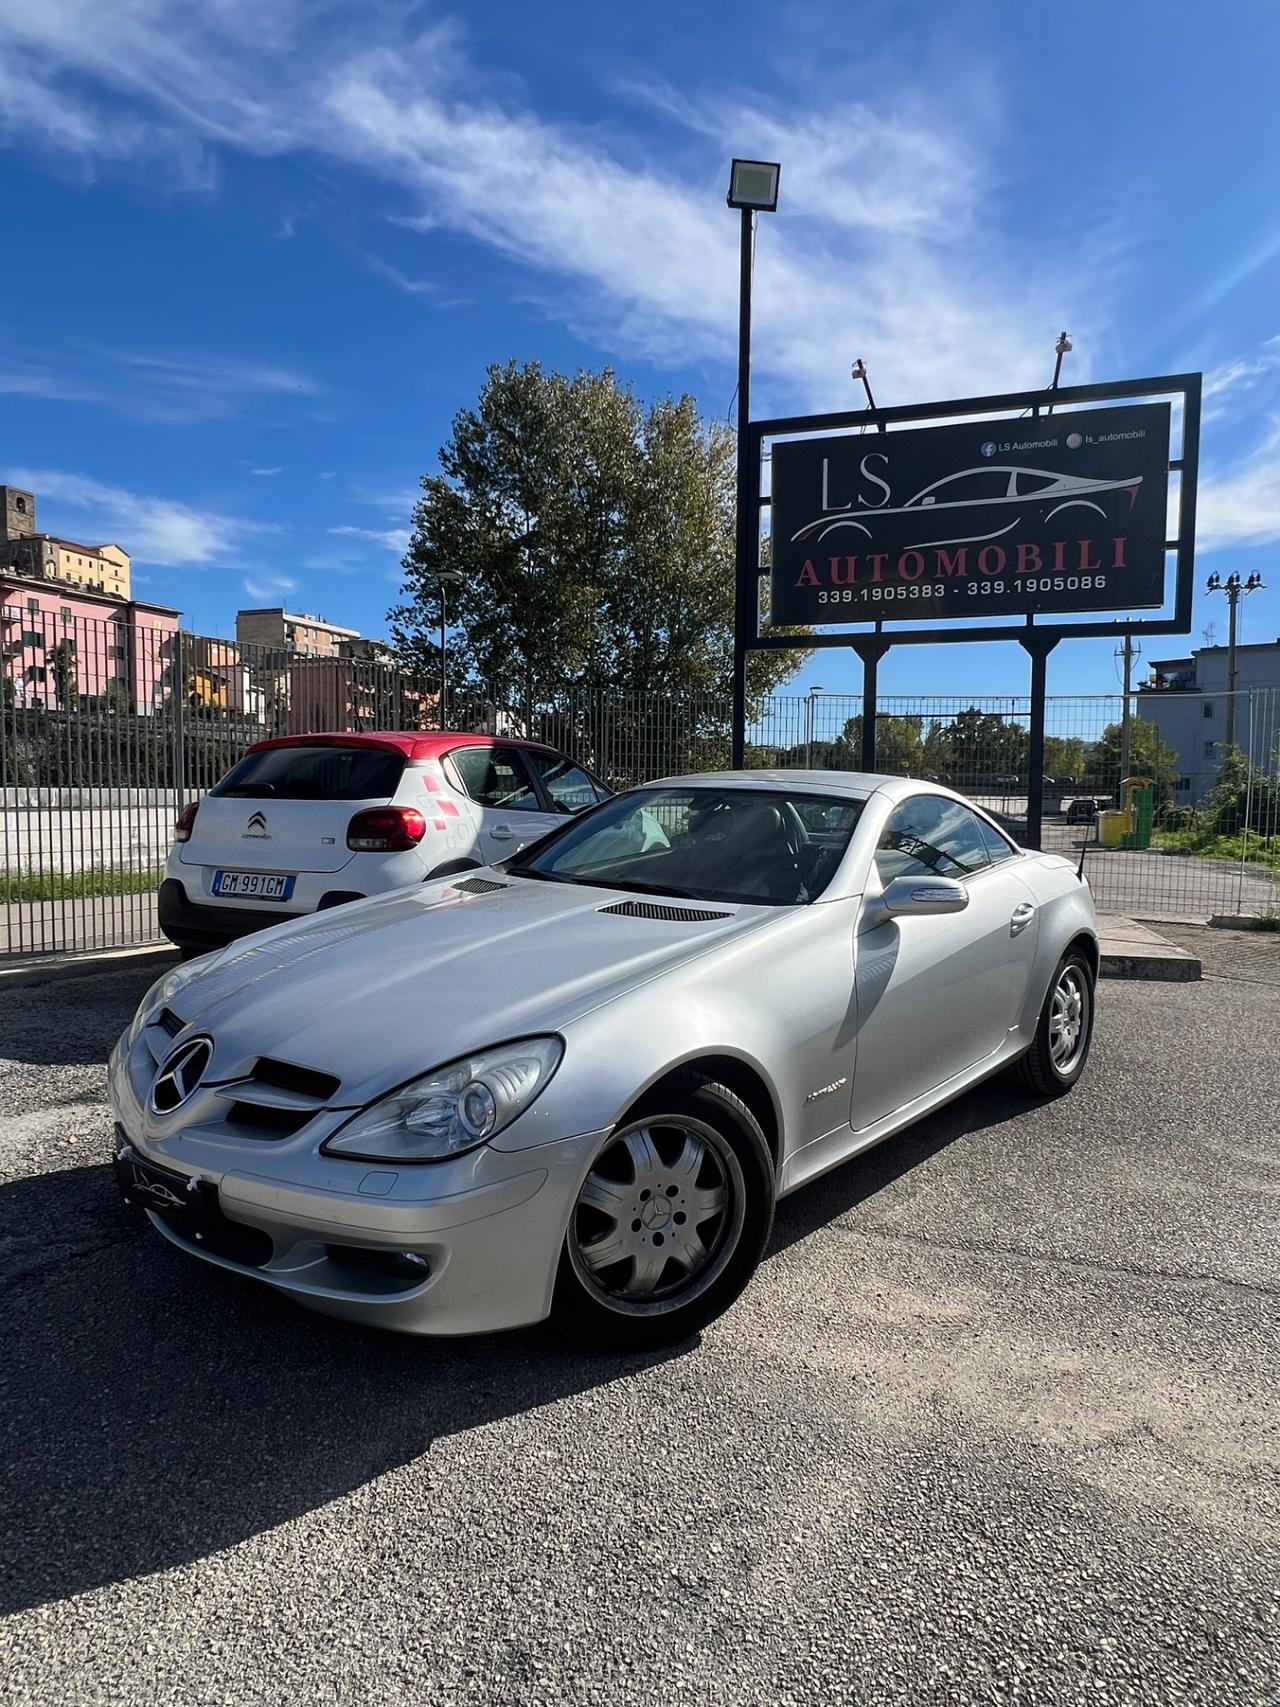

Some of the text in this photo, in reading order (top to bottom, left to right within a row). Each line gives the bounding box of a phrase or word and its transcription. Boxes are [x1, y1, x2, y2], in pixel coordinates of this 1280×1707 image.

[998, 439, 1059, 452] LS Automobili
[1085, 430, 1146, 445] ls_automobili
[822, 452, 891, 511] LS
[793, 537, 1128, 587] AUTOMOBILI
[818, 584, 945, 604] 339.1905383
[967, 575, 1107, 596] 339.1905086
[221, 873, 239, 892] GM
